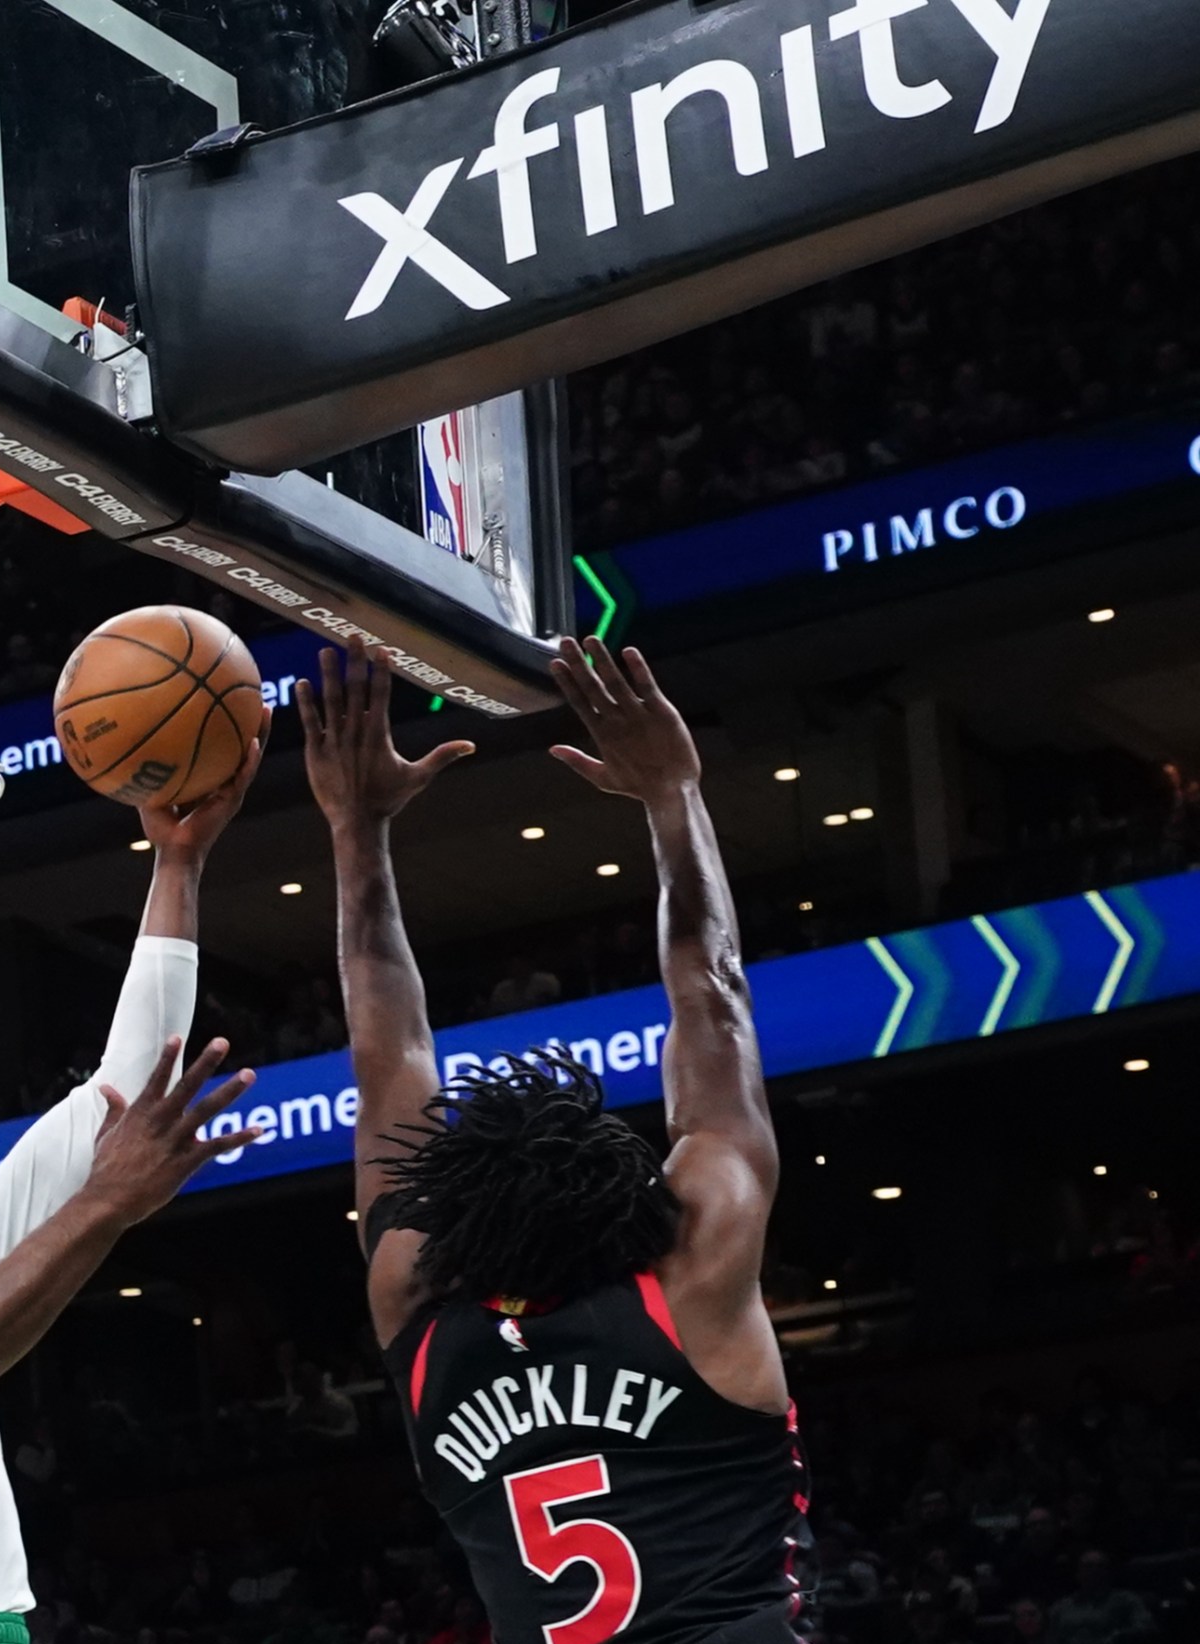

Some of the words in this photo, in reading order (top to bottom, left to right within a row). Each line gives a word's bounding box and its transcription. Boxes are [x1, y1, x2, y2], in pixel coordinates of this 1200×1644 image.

[337, 0, 1052, 320] xfinity
[822, 486, 1027, 572] PIMCO
[434, 1364, 683, 1483] QUICKLEY
